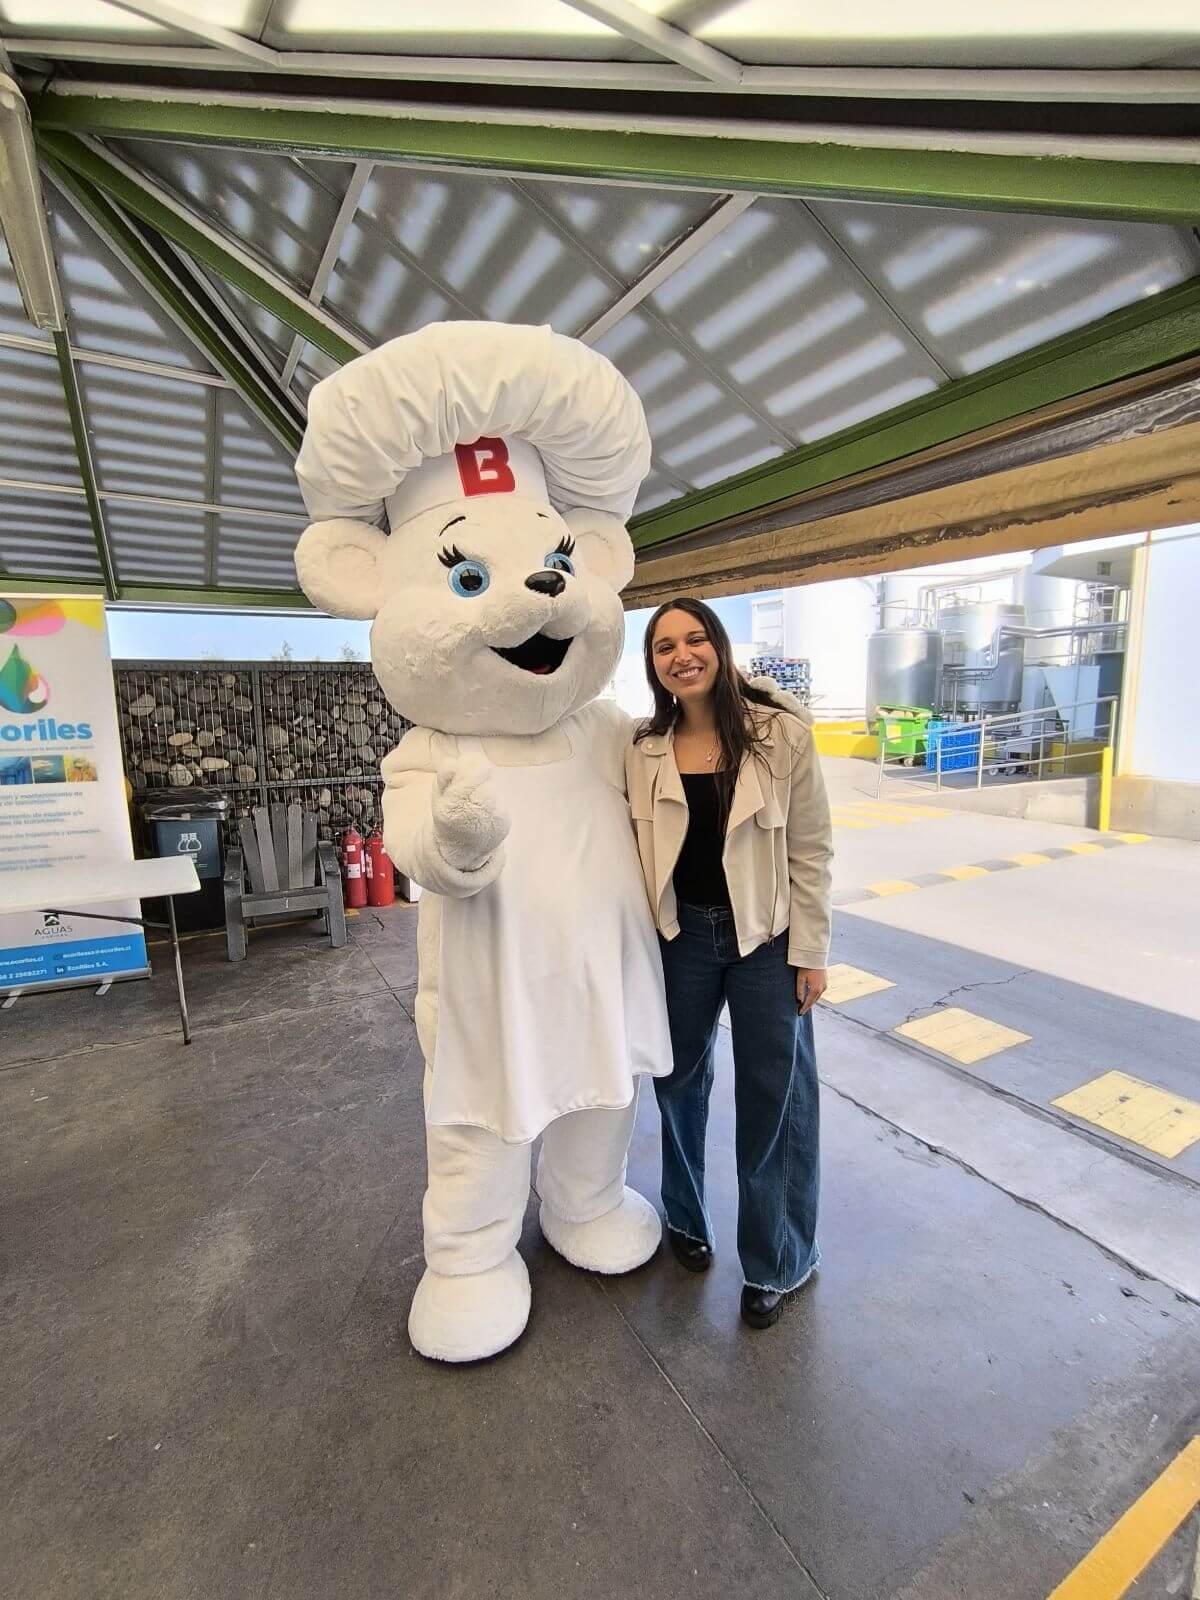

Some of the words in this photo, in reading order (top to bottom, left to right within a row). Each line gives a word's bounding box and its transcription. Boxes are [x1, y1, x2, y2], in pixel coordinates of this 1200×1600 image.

[455, 436, 515, 497] B
[0, 718, 93, 741] oriles
[34, 926, 74, 936] AGUAS
